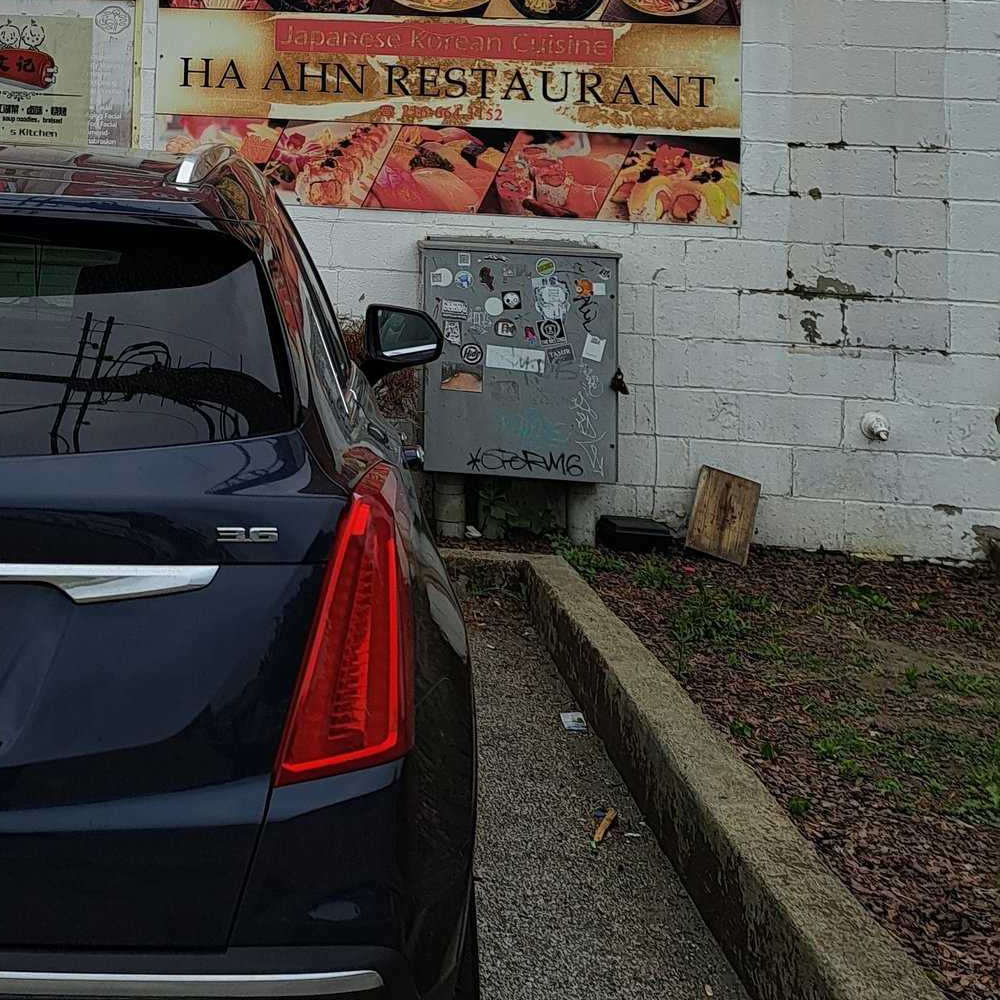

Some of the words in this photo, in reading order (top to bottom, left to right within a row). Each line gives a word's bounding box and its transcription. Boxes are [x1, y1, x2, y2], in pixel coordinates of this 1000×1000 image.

[279, 24, 402, 51] Japanese
[409, 29, 503, 54] Korean
[511, 32, 608, 56] Cuisine
[180, 56, 247, 91] HA
[261, 60, 367, 95] AHN
[382, 64, 717, 109] RESTAURANT
[19, 128, 58, 138] Kitchen
